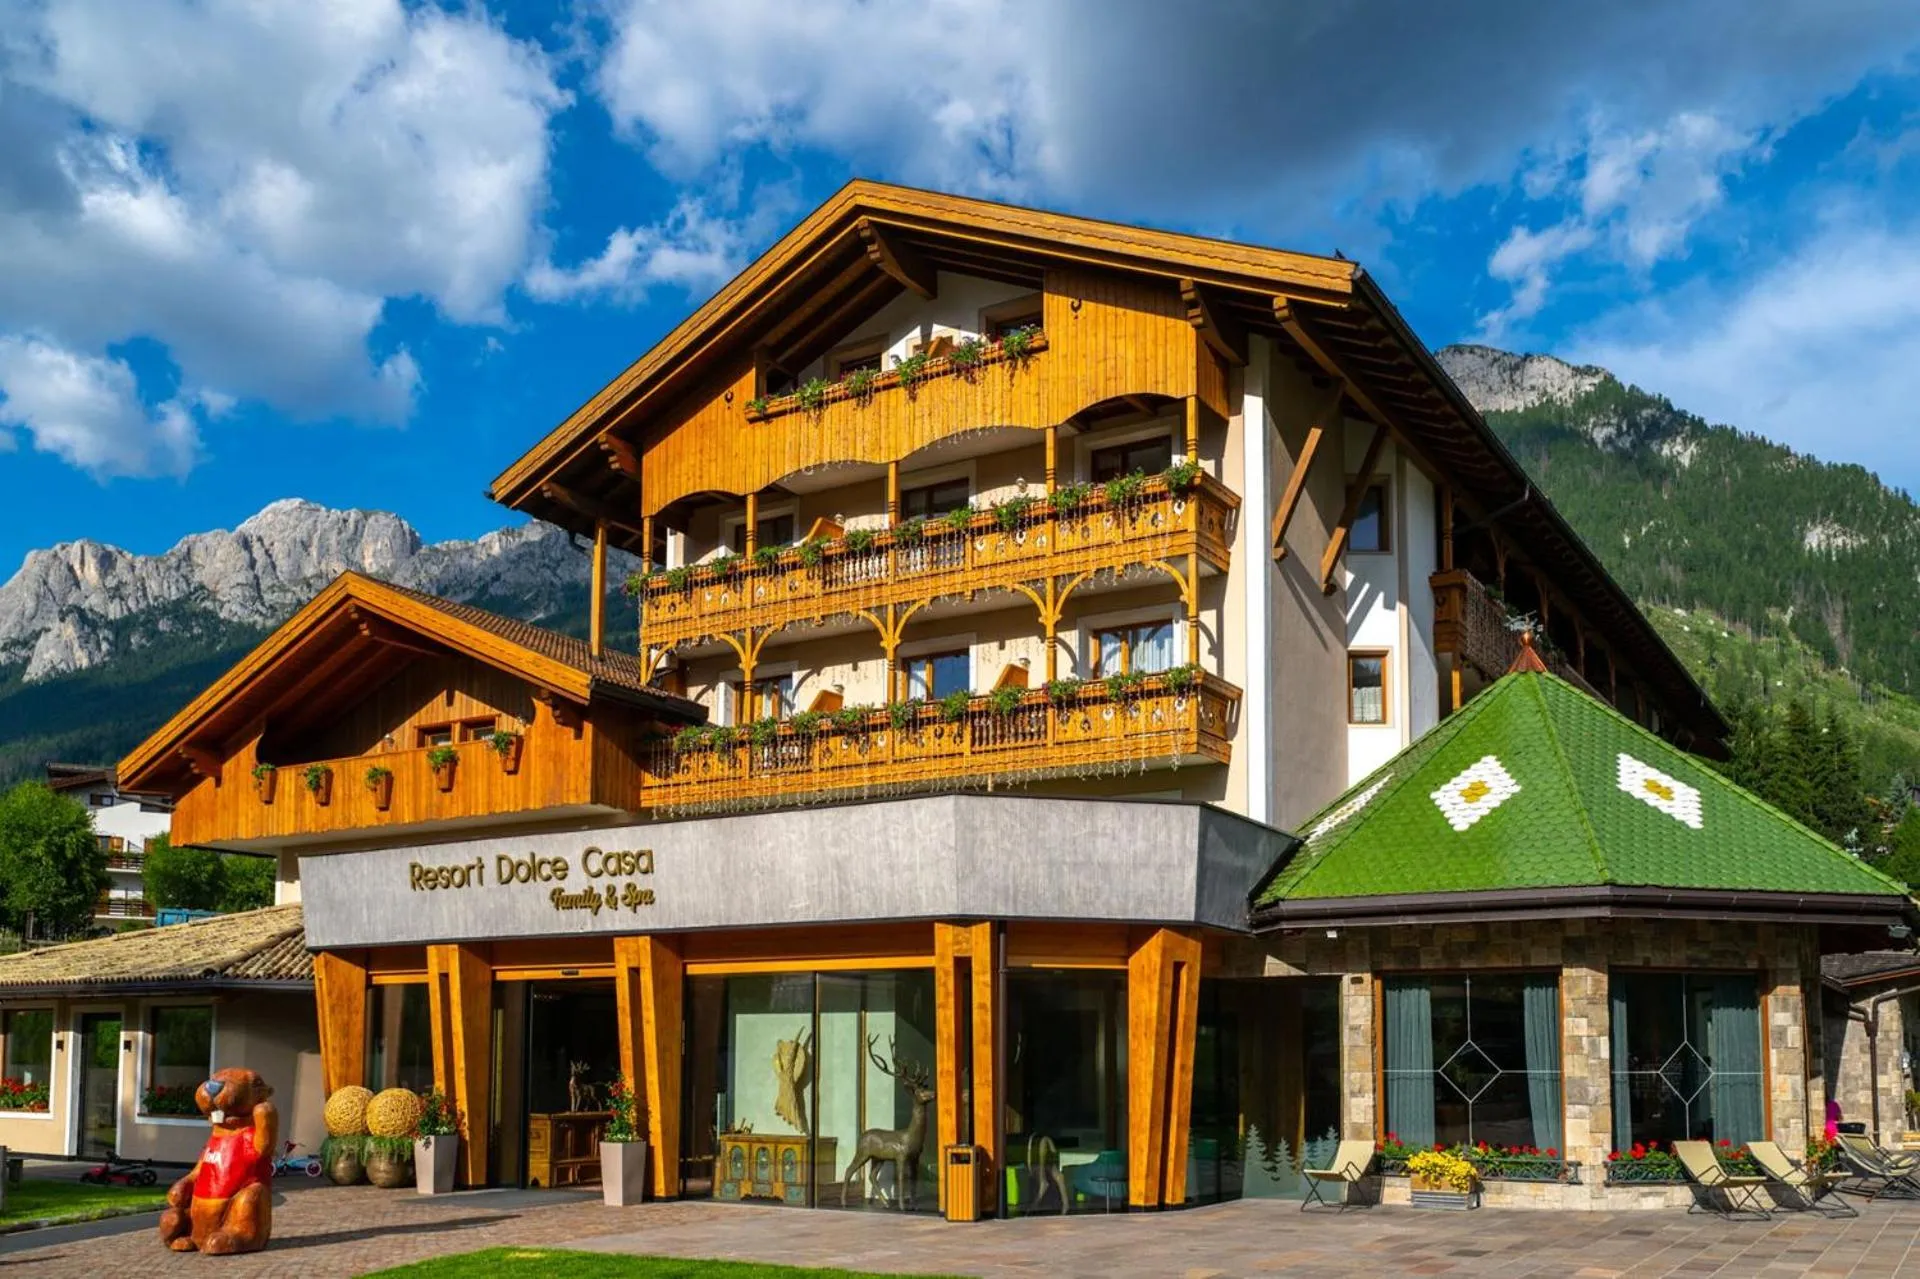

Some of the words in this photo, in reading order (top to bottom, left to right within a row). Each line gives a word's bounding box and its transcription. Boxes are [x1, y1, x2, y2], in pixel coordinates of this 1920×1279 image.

[409, 857, 484, 891] Resort
[496, 852, 568, 884] Dolce
[582, 846, 654, 878] Casa
[551, 886, 602, 916] Family
[603, 883, 618, 911] &
[621, 882, 655, 914] Spa
